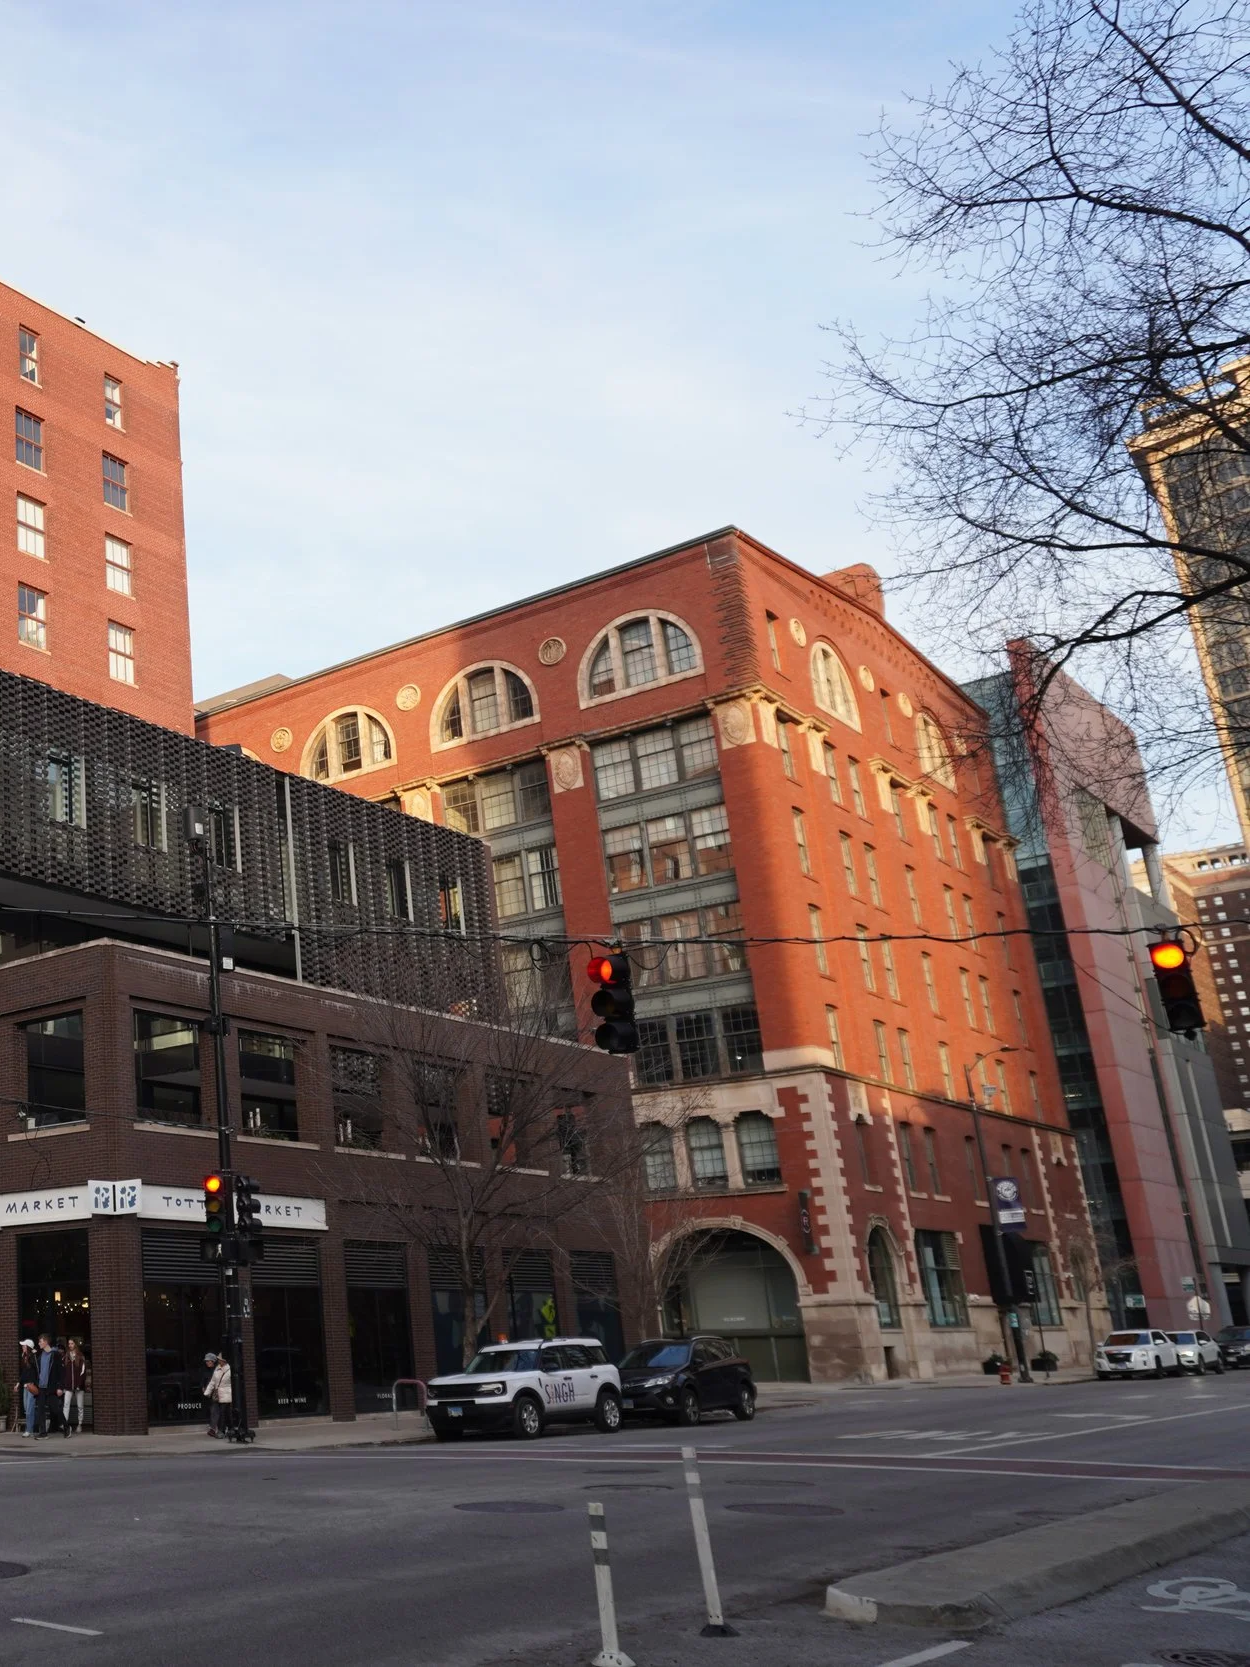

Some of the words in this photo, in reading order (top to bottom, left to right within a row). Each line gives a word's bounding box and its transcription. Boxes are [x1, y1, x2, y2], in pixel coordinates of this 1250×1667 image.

[5, 1196, 79, 1214] MARKET
[162, 1196, 207, 1210] TOTT
[265, 1205, 302, 1217] RKET
[544, 1382, 576, 1404] SINGH
[177, 1402, 202, 1410] PRODUCE
